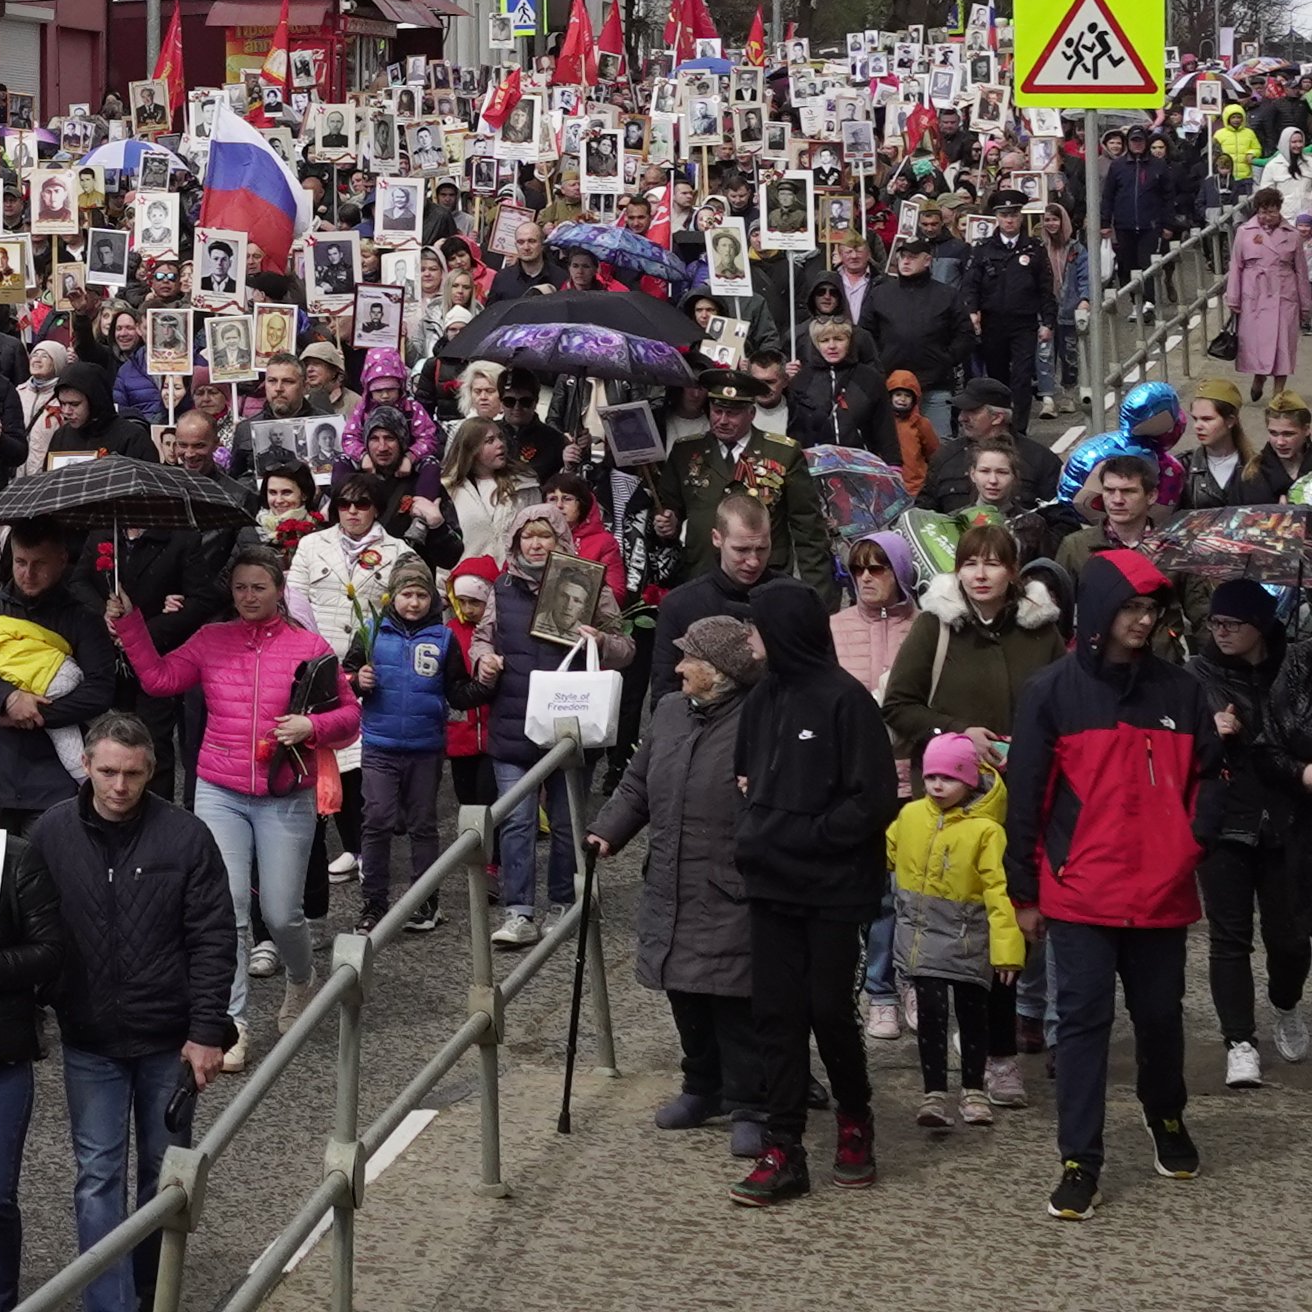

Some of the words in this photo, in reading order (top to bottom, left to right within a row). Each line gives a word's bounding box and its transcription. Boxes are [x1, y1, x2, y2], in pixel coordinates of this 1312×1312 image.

[414, 642, 441, 677] 6
[555, 692, 578, 702] Style
[579, 692, 591, 701] of
[547, 702, 589, 712] Freedom
